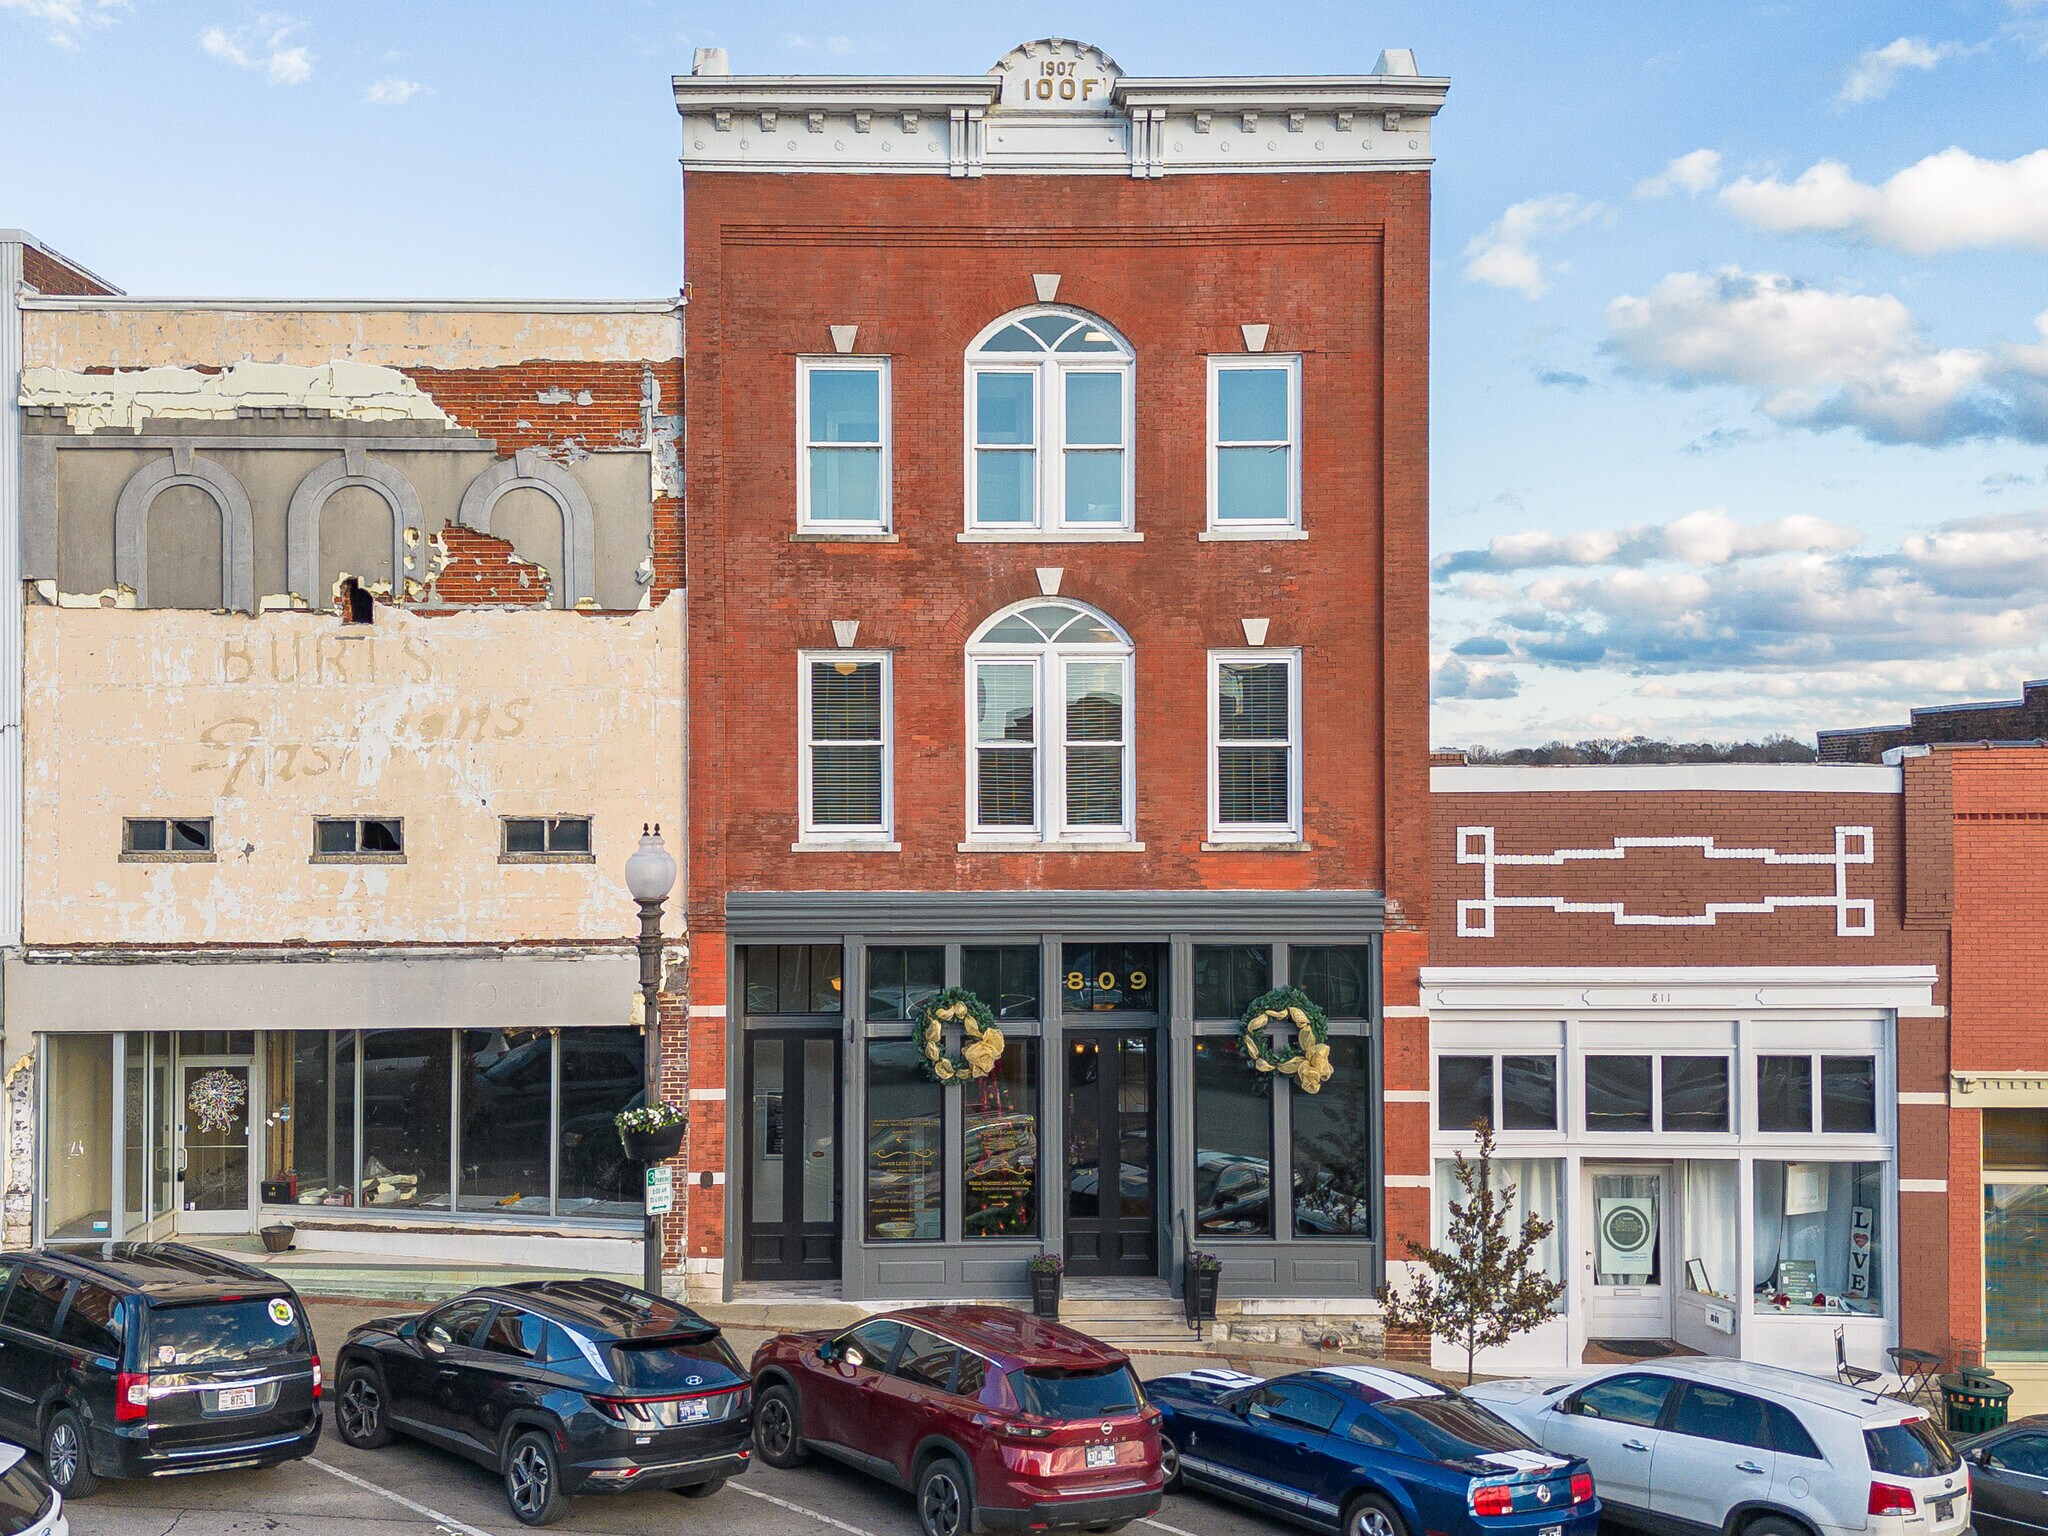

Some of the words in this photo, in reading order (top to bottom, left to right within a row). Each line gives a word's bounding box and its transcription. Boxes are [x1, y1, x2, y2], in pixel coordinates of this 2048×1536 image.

[1040, 61, 1077, 77] 1907
[1025, 78, 1099, 100] IOOF
[1067, 971, 1147, 990] 809
[1651, 992, 1670, 1003] 811
[648, 1172, 655, 1184] 3
